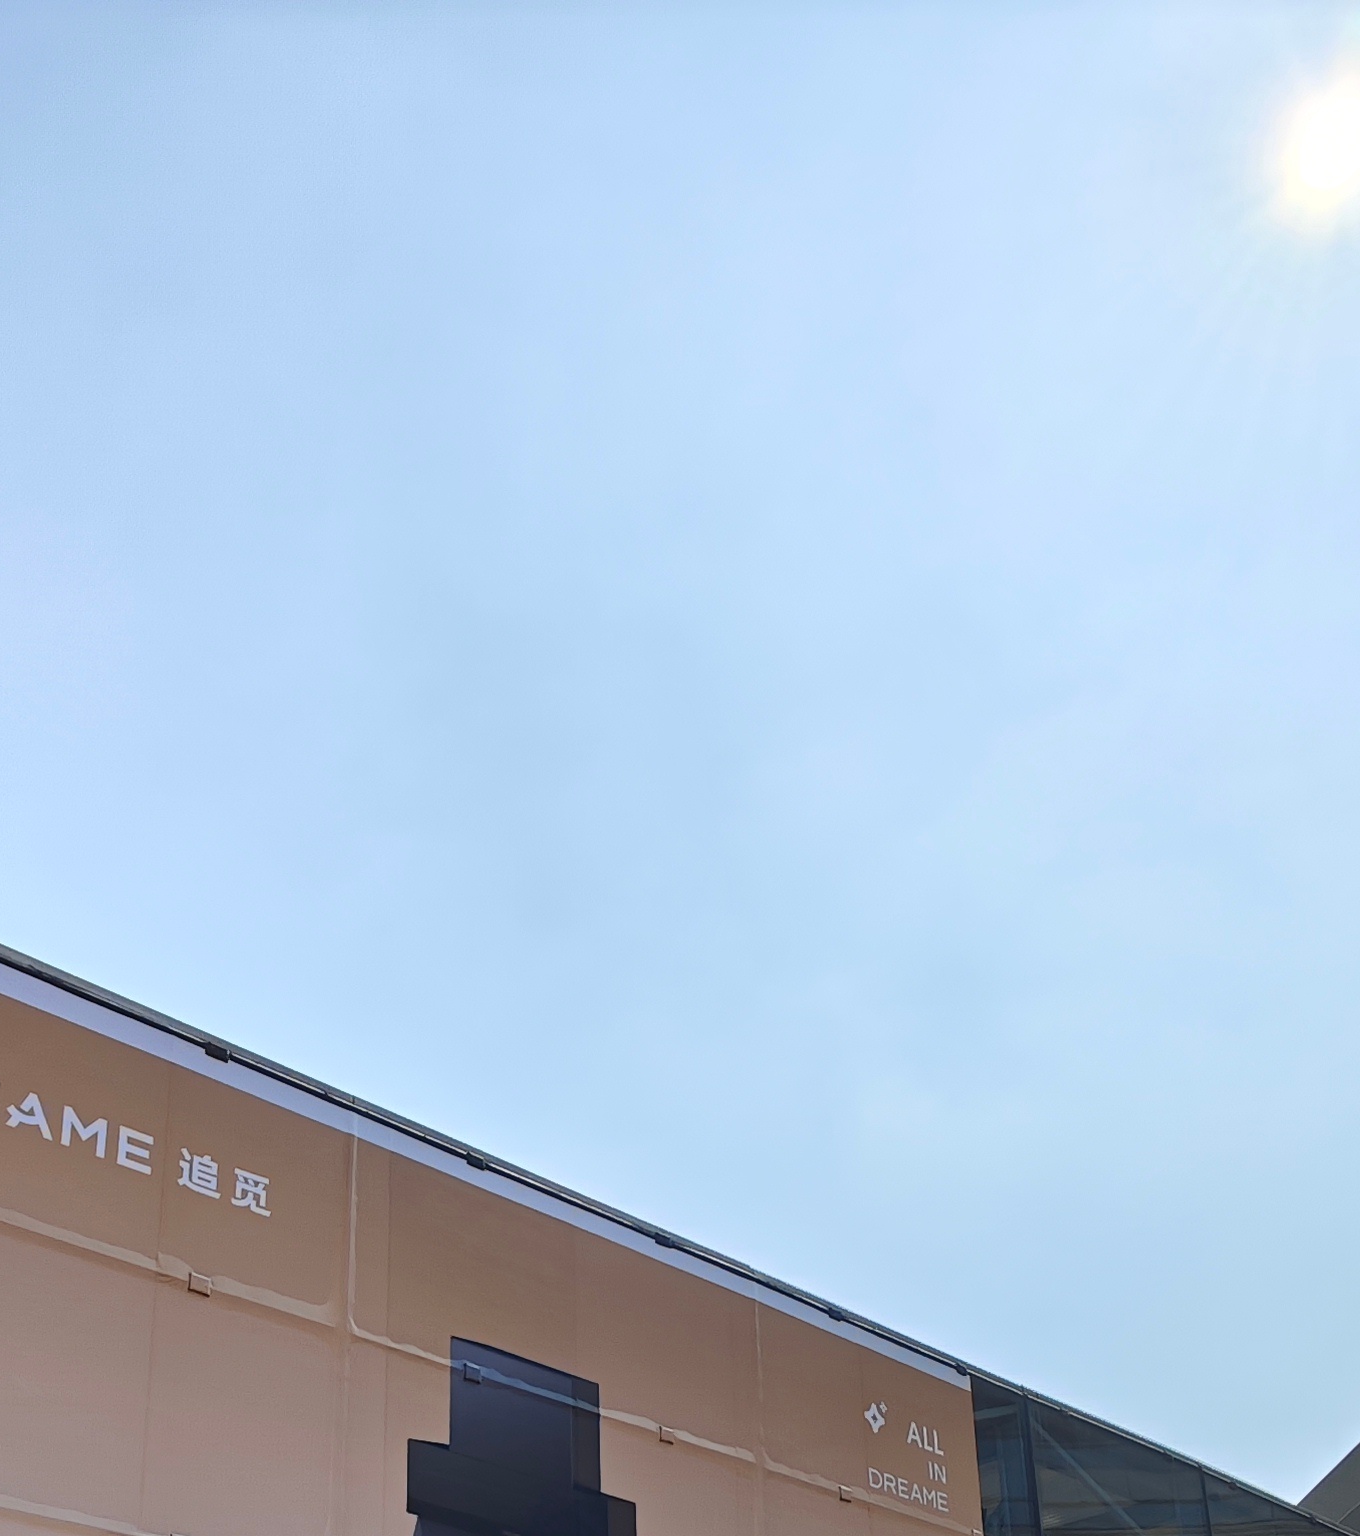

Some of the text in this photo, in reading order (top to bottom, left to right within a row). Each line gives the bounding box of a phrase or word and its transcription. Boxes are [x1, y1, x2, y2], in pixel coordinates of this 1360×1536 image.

[177, 1148, 272, 1218] 追觅
[906, 1421, 944, 1456] ALL
[868, 1467, 949, 1512] DREAME
[928, 1461, 947, 1485] IN
